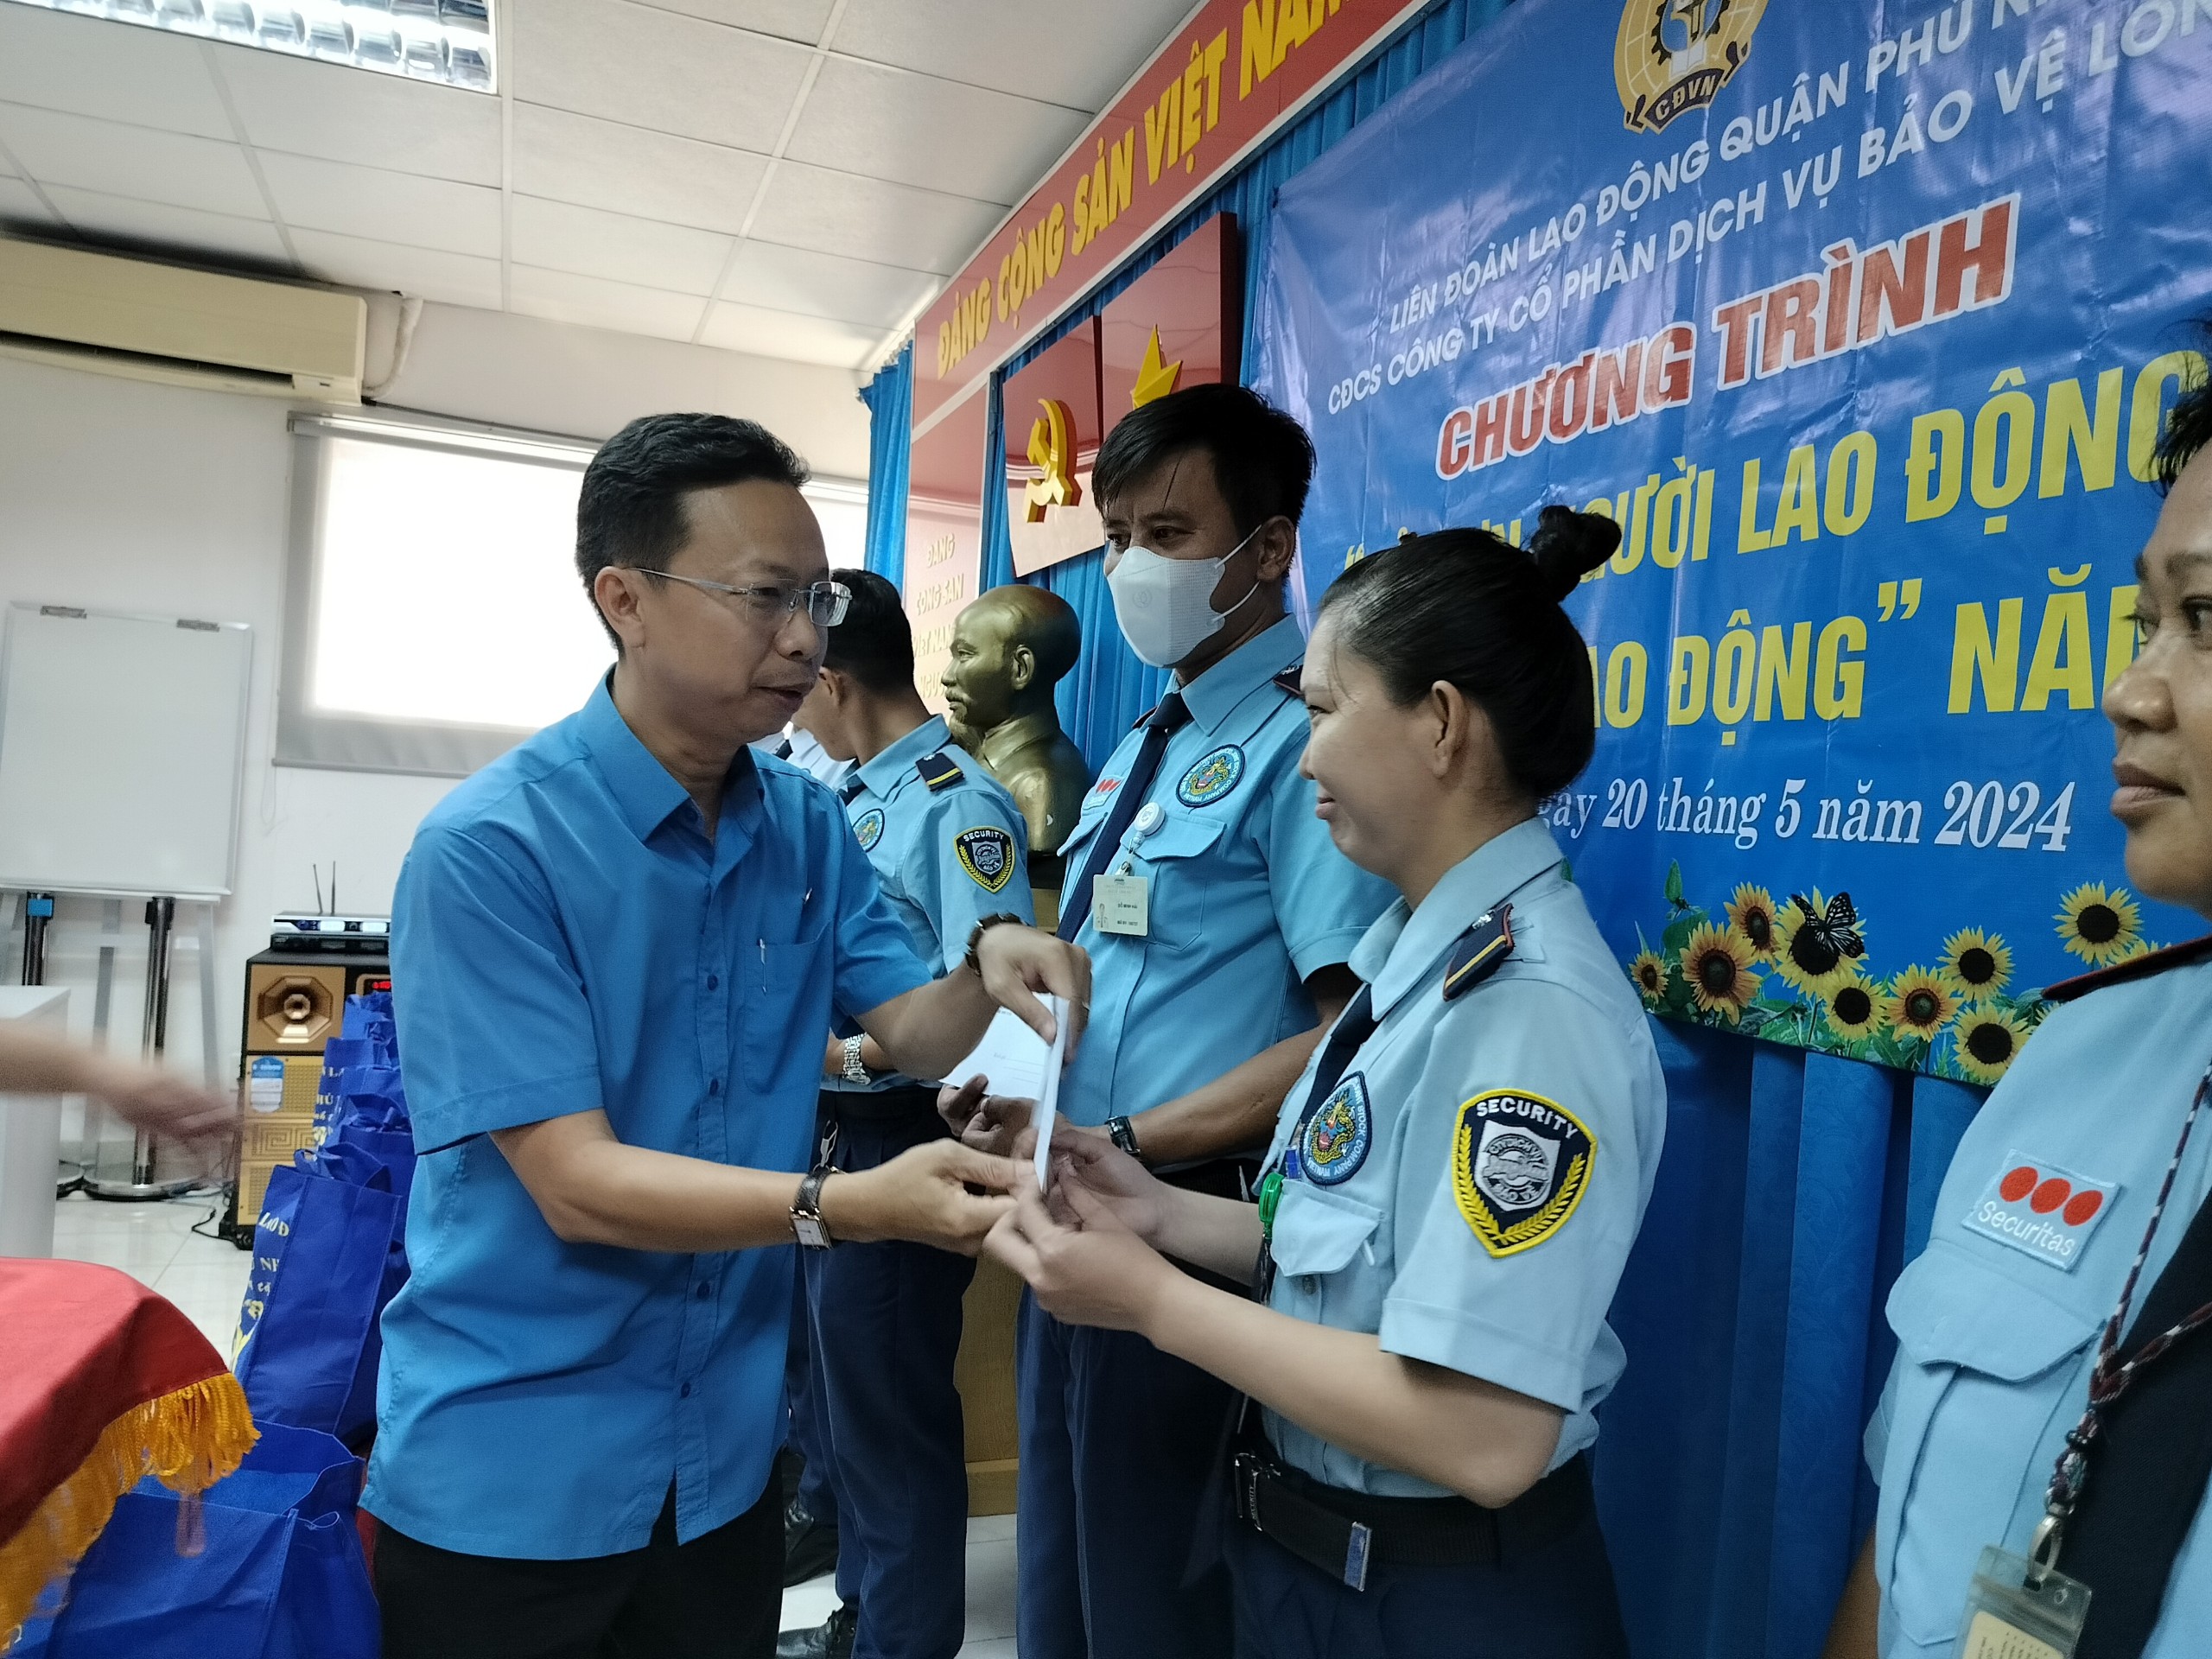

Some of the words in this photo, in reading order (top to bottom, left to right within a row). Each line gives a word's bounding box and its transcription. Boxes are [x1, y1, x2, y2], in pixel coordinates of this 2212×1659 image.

[938, 276, 992, 379] ĐẢNG
[997, 202, 1065, 329] CỘNG
[1071, 126, 1135, 256] SẢN
[1144, 28, 1228, 186] VIỆT
[1328, 363, 1382, 416] CĐCS
[1387, 327, 1464, 386] CÔNG
[1470, 307, 1501, 351] TY
[1508, 262, 1553, 333] CỔ
[1561, 224, 1656, 308] PHẦN
[1667, 181, 1768, 264] DỊCH
[1783, 146, 1842, 208] VỤ
[1857, 88, 1973, 179] BẢO
[1993, 26, 2067, 115] VỆ
[1389, 283, 1438, 334] LIÊN
[1443, 236, 1520, 307] ĐOÀN
[1527, 203, 1587, 263] LAO
[1595, 141, 1710, 222] ĐỘNG
[1719, 60, 1849, 162] QUẬN
[1436, 321, 1696, 481] CHƯƠNG
[1711, 192, 2021, 391] TRÌNH
[1737, 429, 1877, 556] LAO
[963, 830, 1004, 842] SECURITY
[1601, 778, 1649, 830] 20
[1656, 777, 1767, 850] tháng
[1775, 778, 1807, 838] 5
[1812, 779, 1923, 844] năm
[1934, 780, 2075, 852] 2024
[1333, 1139, 1364, 1176] COMPANY
[1476, 1096, 1580, 1140] SECURITY
[1978, 1200, 2075, 1256] Securitas
